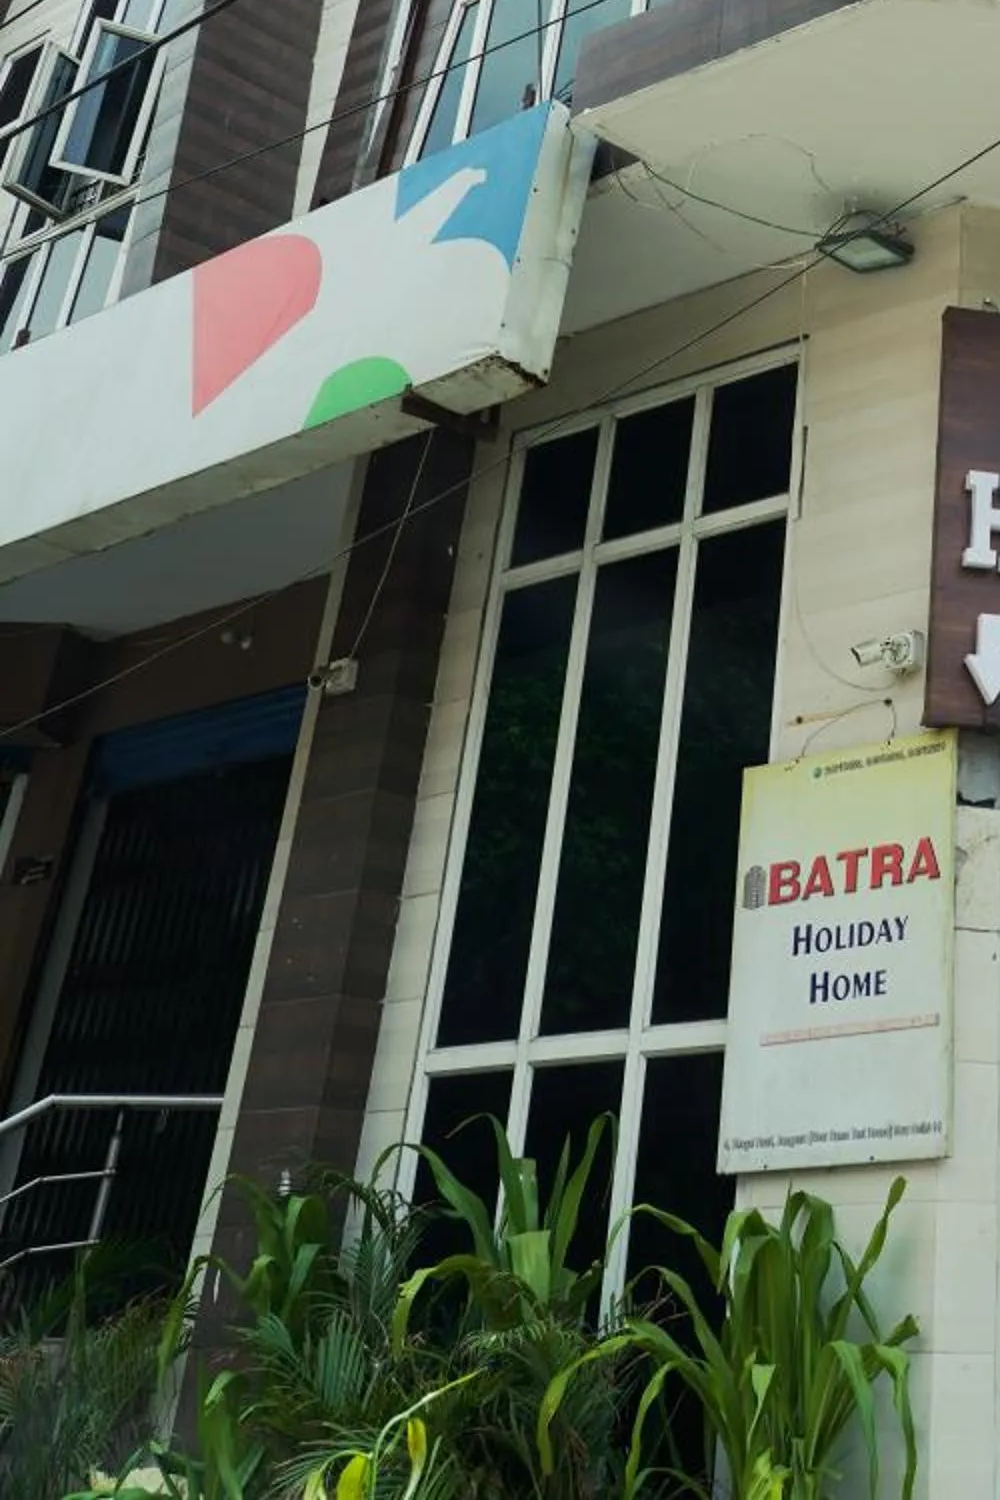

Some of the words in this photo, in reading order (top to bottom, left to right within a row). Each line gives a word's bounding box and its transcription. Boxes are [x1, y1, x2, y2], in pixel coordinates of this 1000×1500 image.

[767, 836, 941, 907] BATRA
[791, 916, 909, 957] HOLIDAY
[808, 969, 888, 1004] HOME
